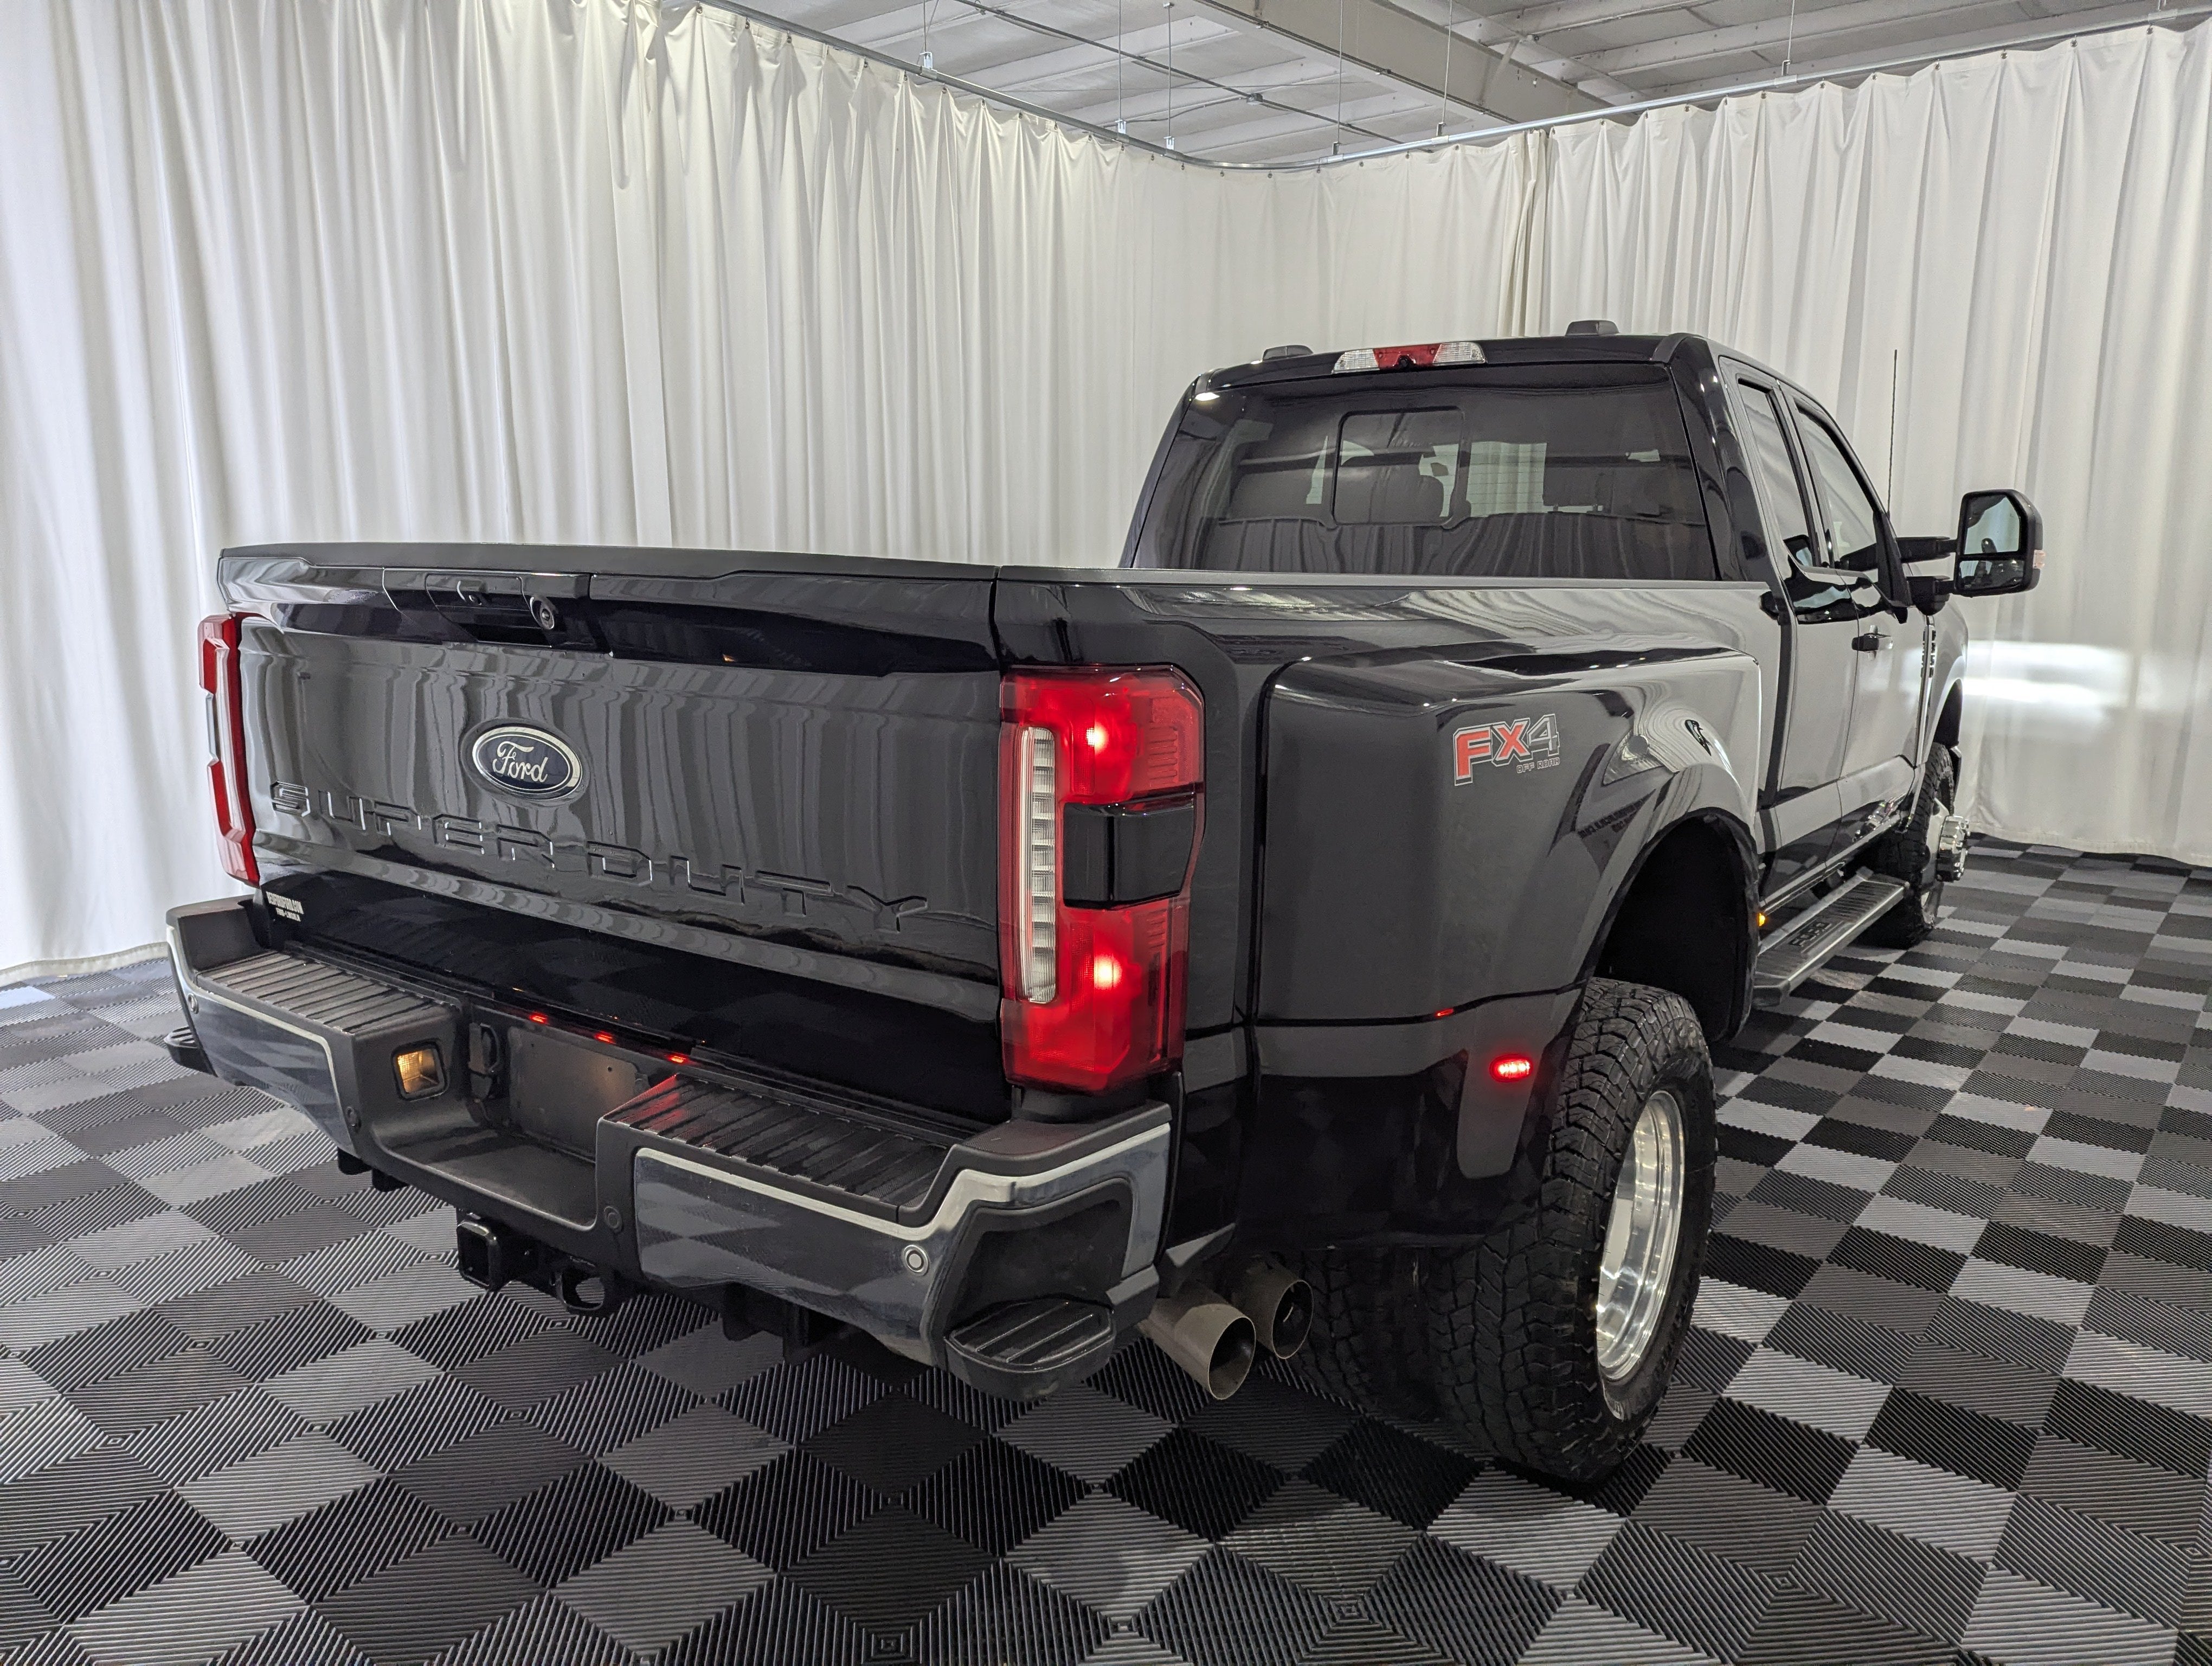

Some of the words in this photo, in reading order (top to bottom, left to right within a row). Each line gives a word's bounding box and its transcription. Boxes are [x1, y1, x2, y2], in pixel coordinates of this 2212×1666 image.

[492, 741, 549, 783] Ford
[1453, 714, 1560, 786] FX4
[1516, 761, 1535, 774] OFF
[1537, 757, 1560, 770] ROAD
[271, 781, 556, 868] SUPER
[587, 841, 928, 933] DUTY
